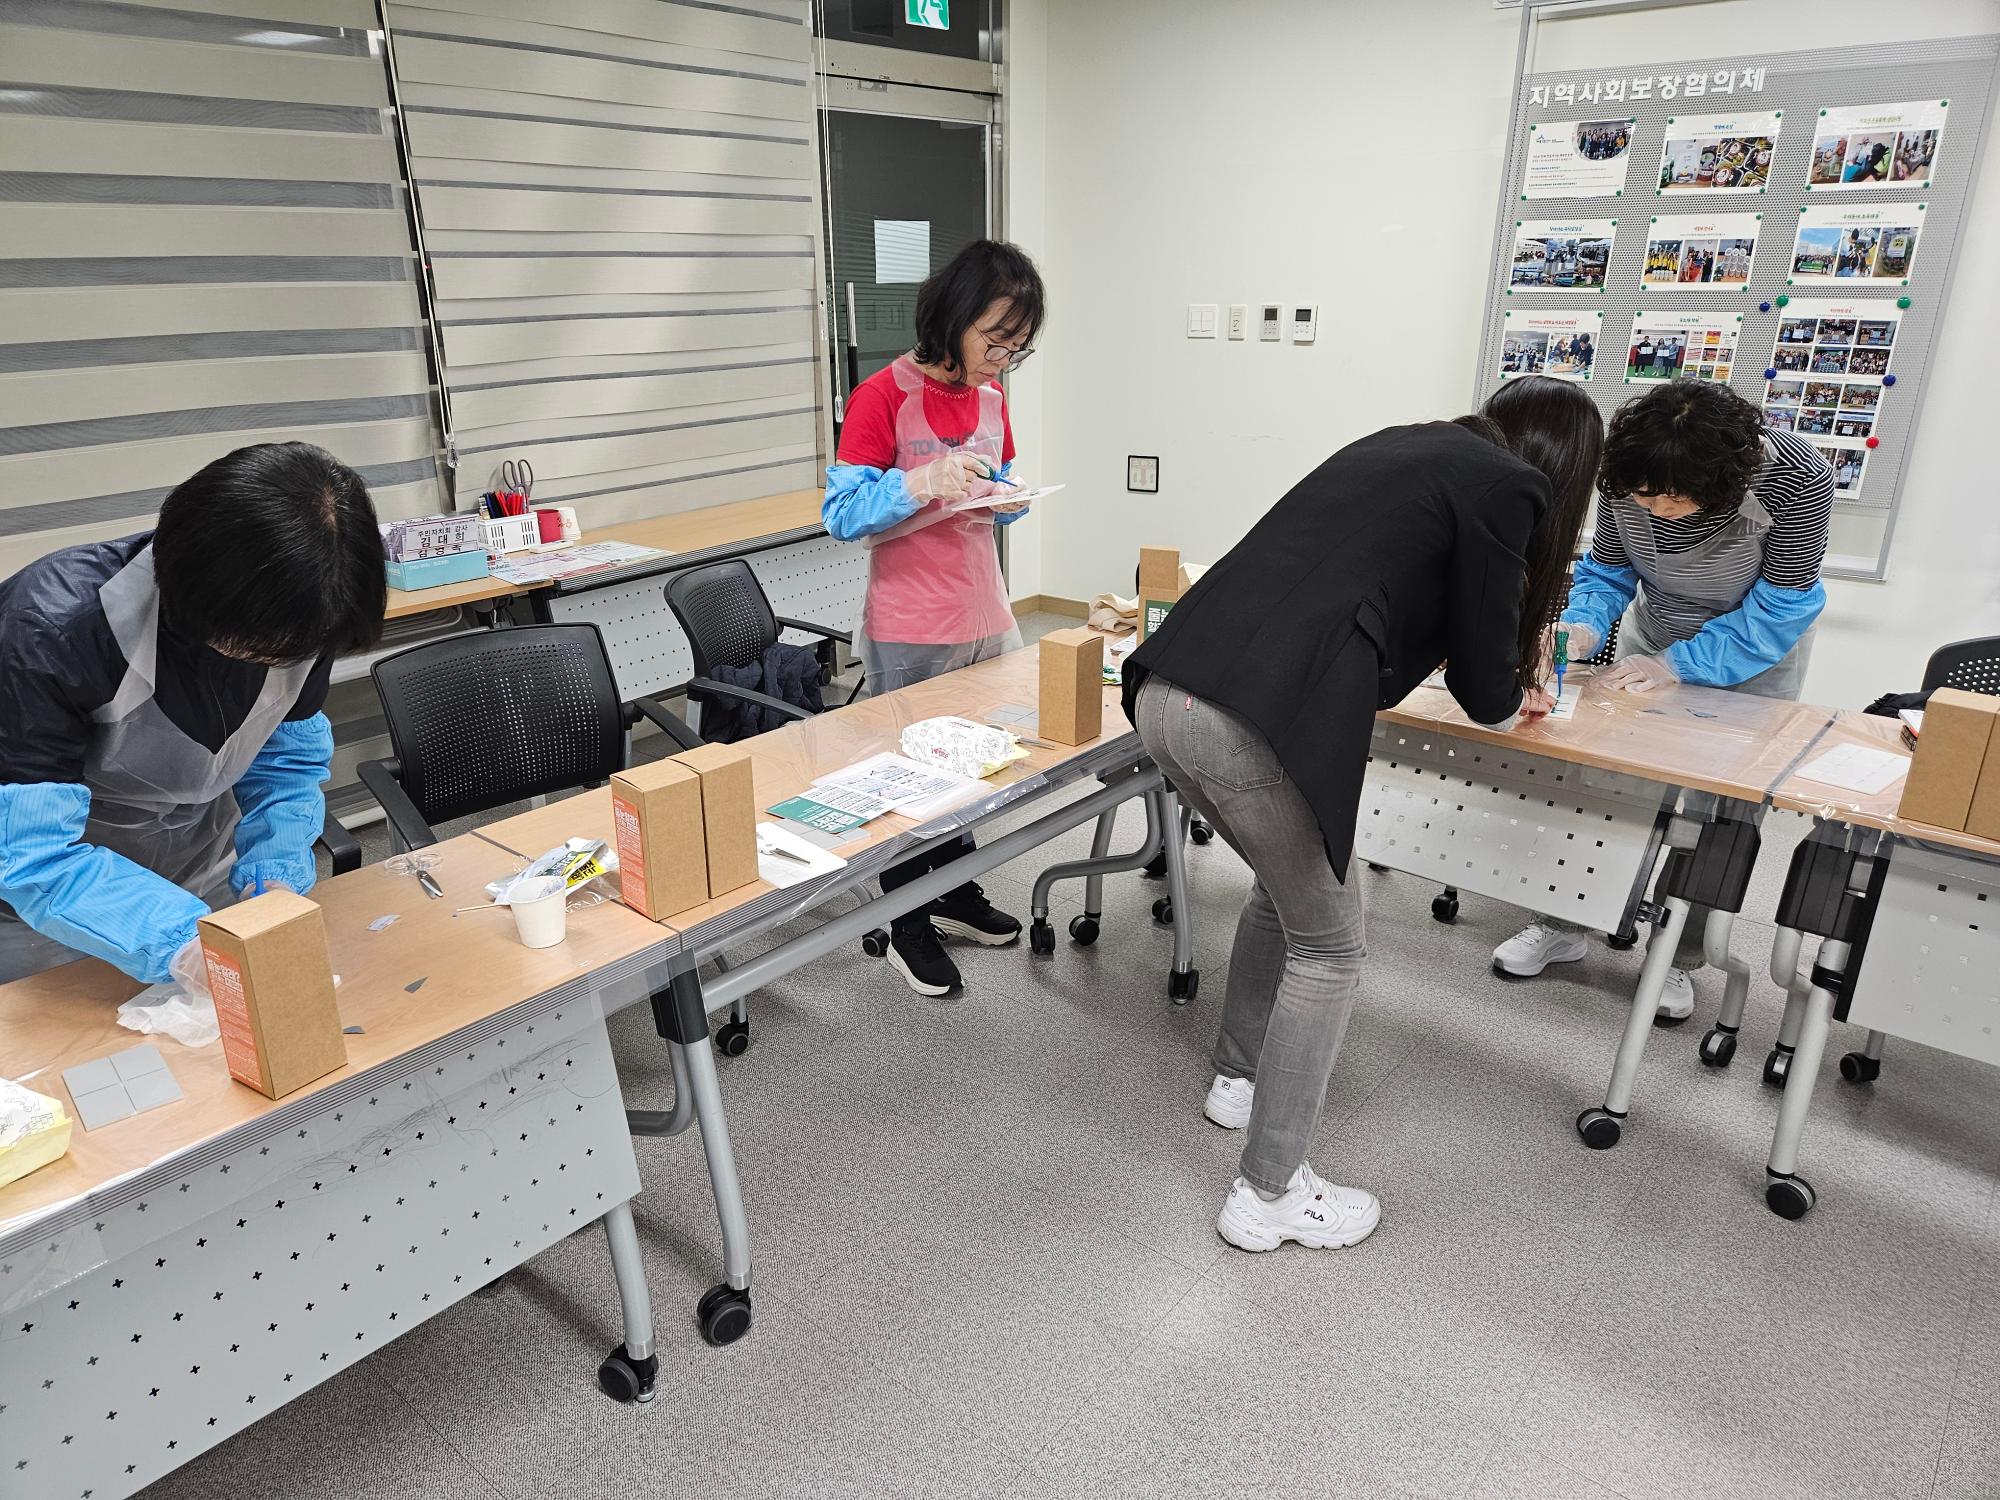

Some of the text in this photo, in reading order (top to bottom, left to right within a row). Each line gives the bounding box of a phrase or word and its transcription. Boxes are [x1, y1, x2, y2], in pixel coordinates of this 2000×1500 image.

[1529, 67, 1766, 108] 지역사회보장협의체
[418, 526, 451, 537] 주민자치회
[438, 534, 448, 545] 대
[1304, 1208, 1325, 1222] FILA
